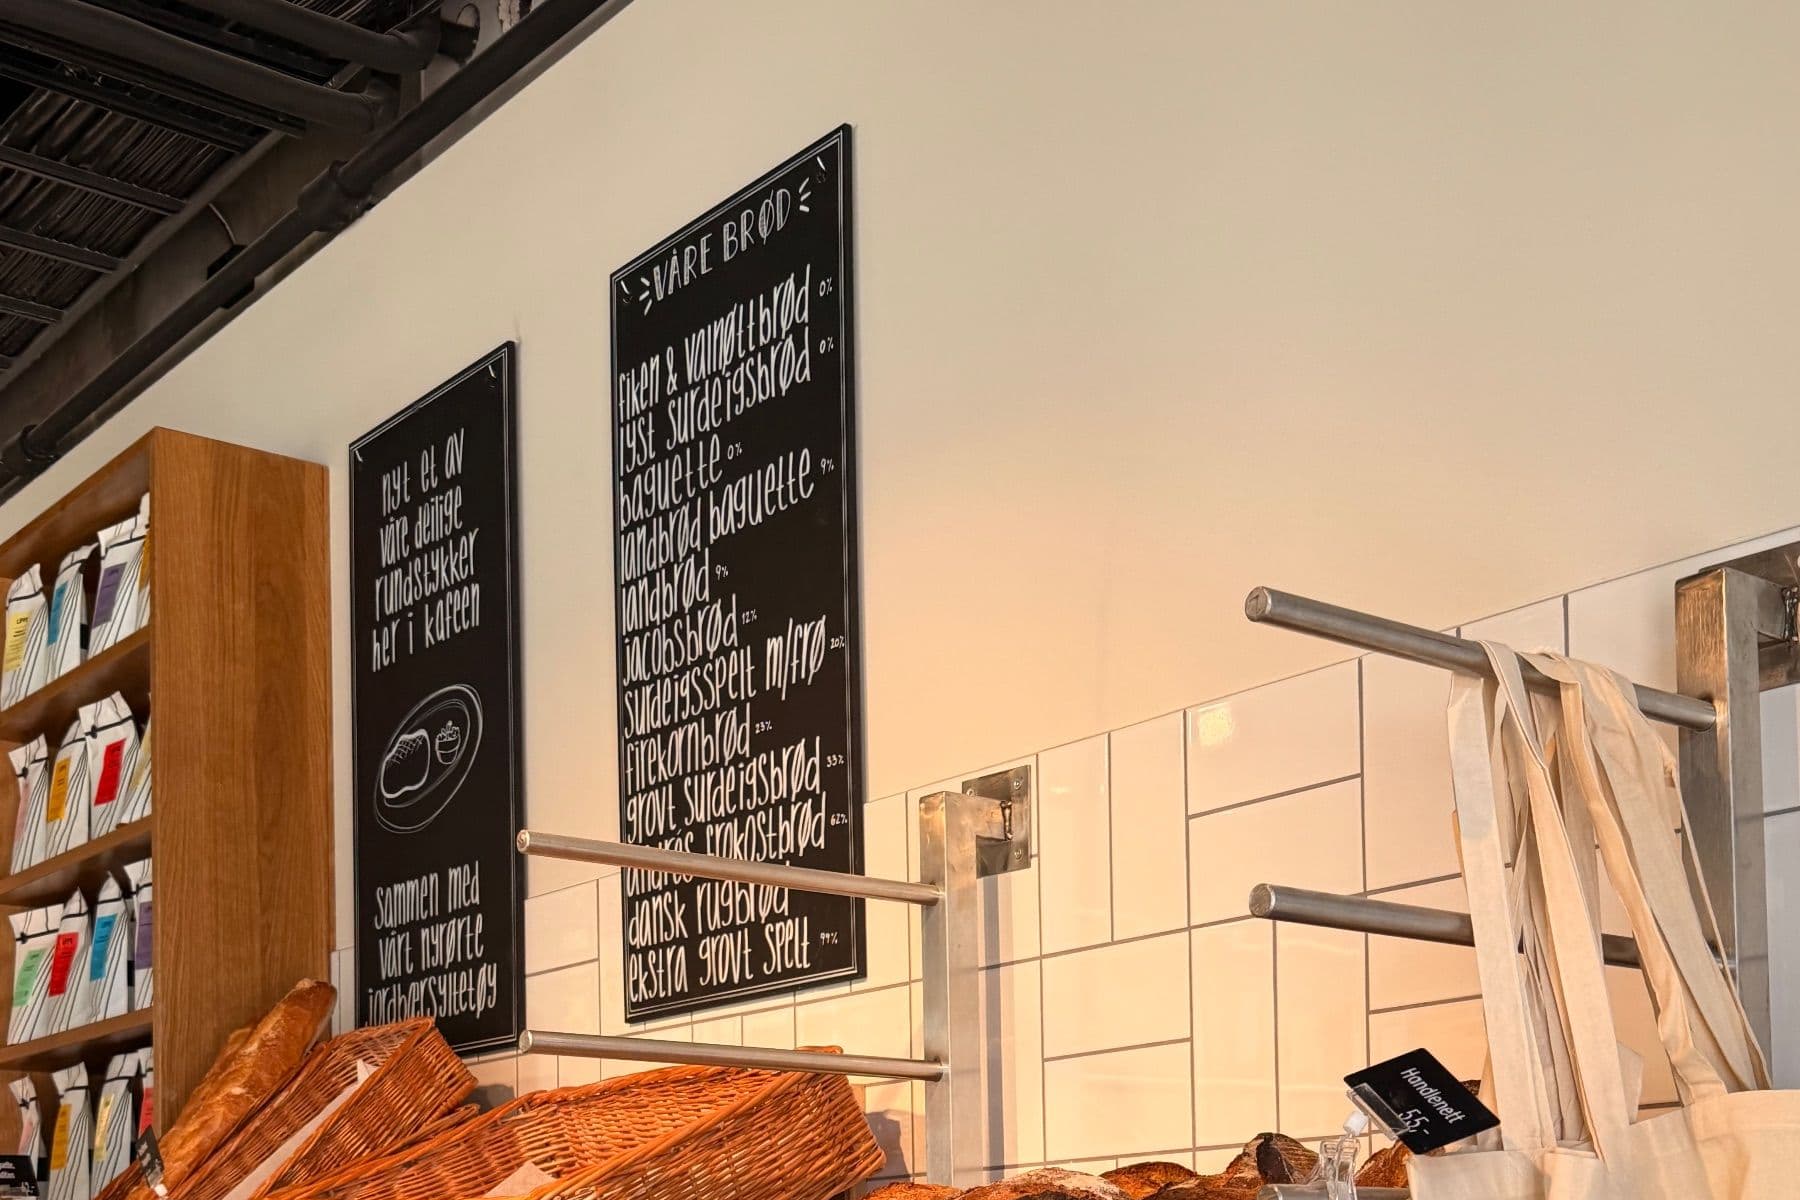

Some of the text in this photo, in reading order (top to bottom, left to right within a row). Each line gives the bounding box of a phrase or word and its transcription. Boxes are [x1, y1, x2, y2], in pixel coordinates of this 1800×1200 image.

[653, 187, 791, 301] VÅRE BRØD
[619, 353, 660, 424] fiken
[666, 346, 678, 396] &
[819, 276, 833, 297] 0%
[619, 326, 834, 478] lyst surdeigsbrød 0%
[382, 427, 465, 517] nyt et av
[619, 433, 743, 531] baguette 0%
[621, 448, 835, 585] landbrød baguette 9%
[379, 485, 463, 568] våre deilige
[375, 527, 480, 622] rundstykker
[622, 547, 729, 636] landbrød 9%
[372, 582, 480, 673] her i kafeen
[623, 593, 738, 687] jacobsbrød
[624, 645, 757, 739] surdeigsspelt
[766, 614, 827, 700] m/frø
[625, 702, 751, 796] firekornbrød
[627, 783, 677, 844] grovt
[684, 735, 821, 827] surdeigsbrød
[374, 860, 480, 930] sammen med
[629, 889, 689, 950] dansk
[379, 913, 485, 981] vårt nyrørte
[630, 945, 689, 1003] ekstra
[699, 927, 754, 986] grovt
[762, 916, 811, 975] spelt
[1400, 1066, 1467, 1125] Handlenett
